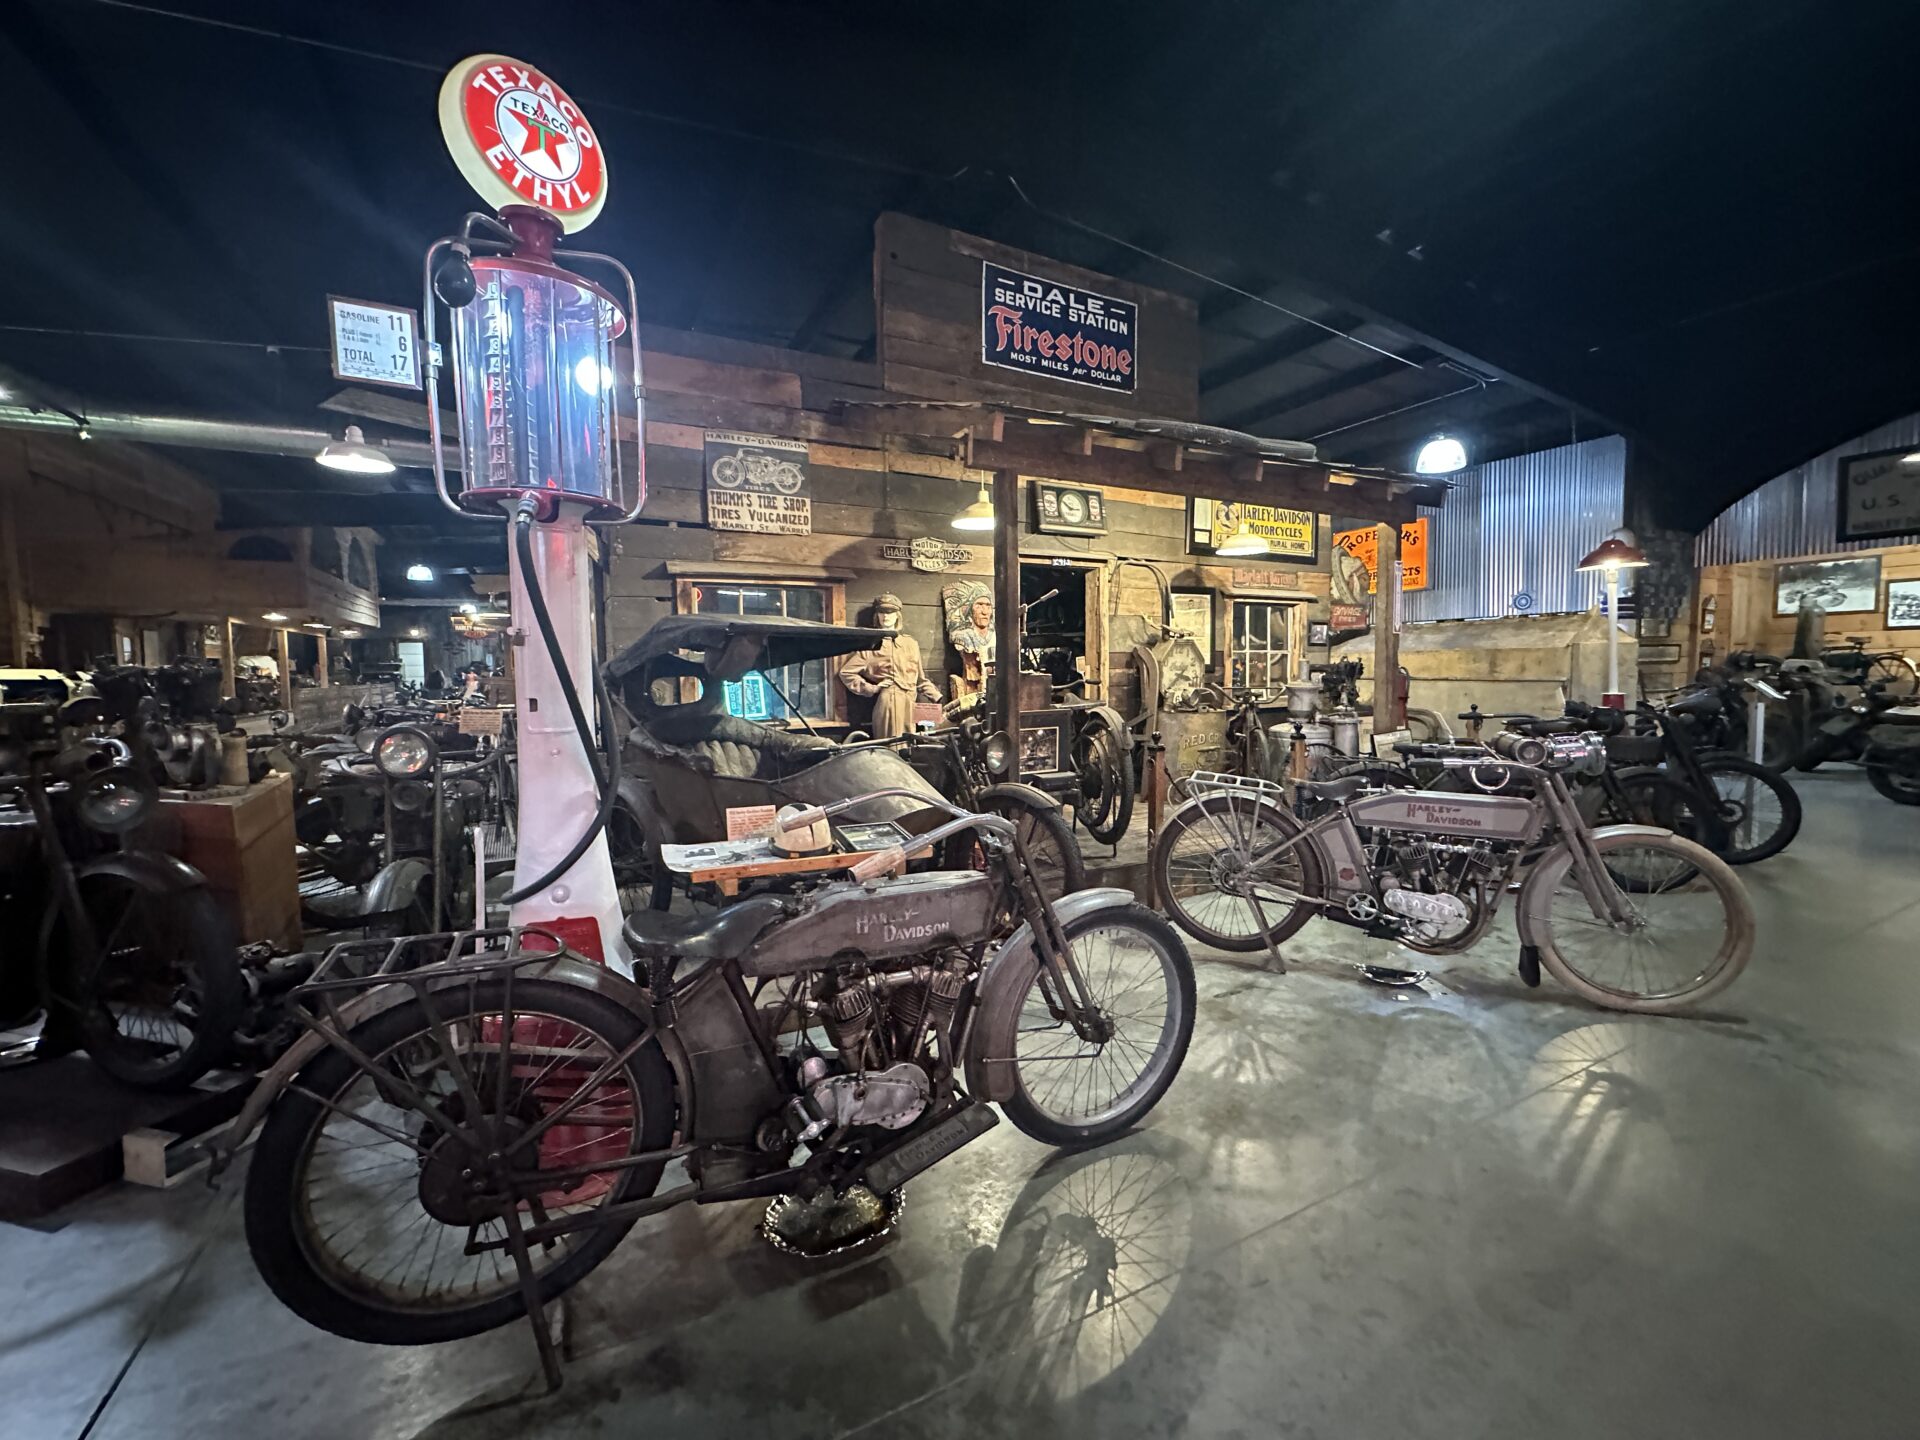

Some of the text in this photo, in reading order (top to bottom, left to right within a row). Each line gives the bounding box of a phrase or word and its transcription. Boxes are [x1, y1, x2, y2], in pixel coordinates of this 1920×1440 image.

[472, 66, 593, 148] TEXACO
[510, 97, 568, 134] TEXACO
[485, 144, 590, 208] ETHYL
[1023, 281, 1104, 315] DALE
[340, 310, 380, 324] GASOLINE
[995, 288, 1128, 335] SERVICE STATION
[399, 336, 407, 352] 6
[988, 305, 1132, 375] Firestone
[343, 348, 375, 362] TOTAL
[391, 354, 407, 371] 17
[1010, 352, 1121, 383] MOST MILES per DOLLAR
[706, 433, 808, 450] HARLEY-DAVIDSON
[710, 490, 752, 508] THUMM'S
[757, 495, 778, 510] TIRE
[711, 507, 809, 526] TIRES VULCANIZED
[721, 521, 754, 531] MARKET
[779, 525, 810, 535] WARREN
[1249, 522, 1303, 538] MOTORCYCLES
[1290, 542, 1305, 550] HOME
[1183, 733, 1206, 750] RED
[1426, 813, 1482, 827] DAVIDSON
[884, 921, 950, 943] DAVIDSON
